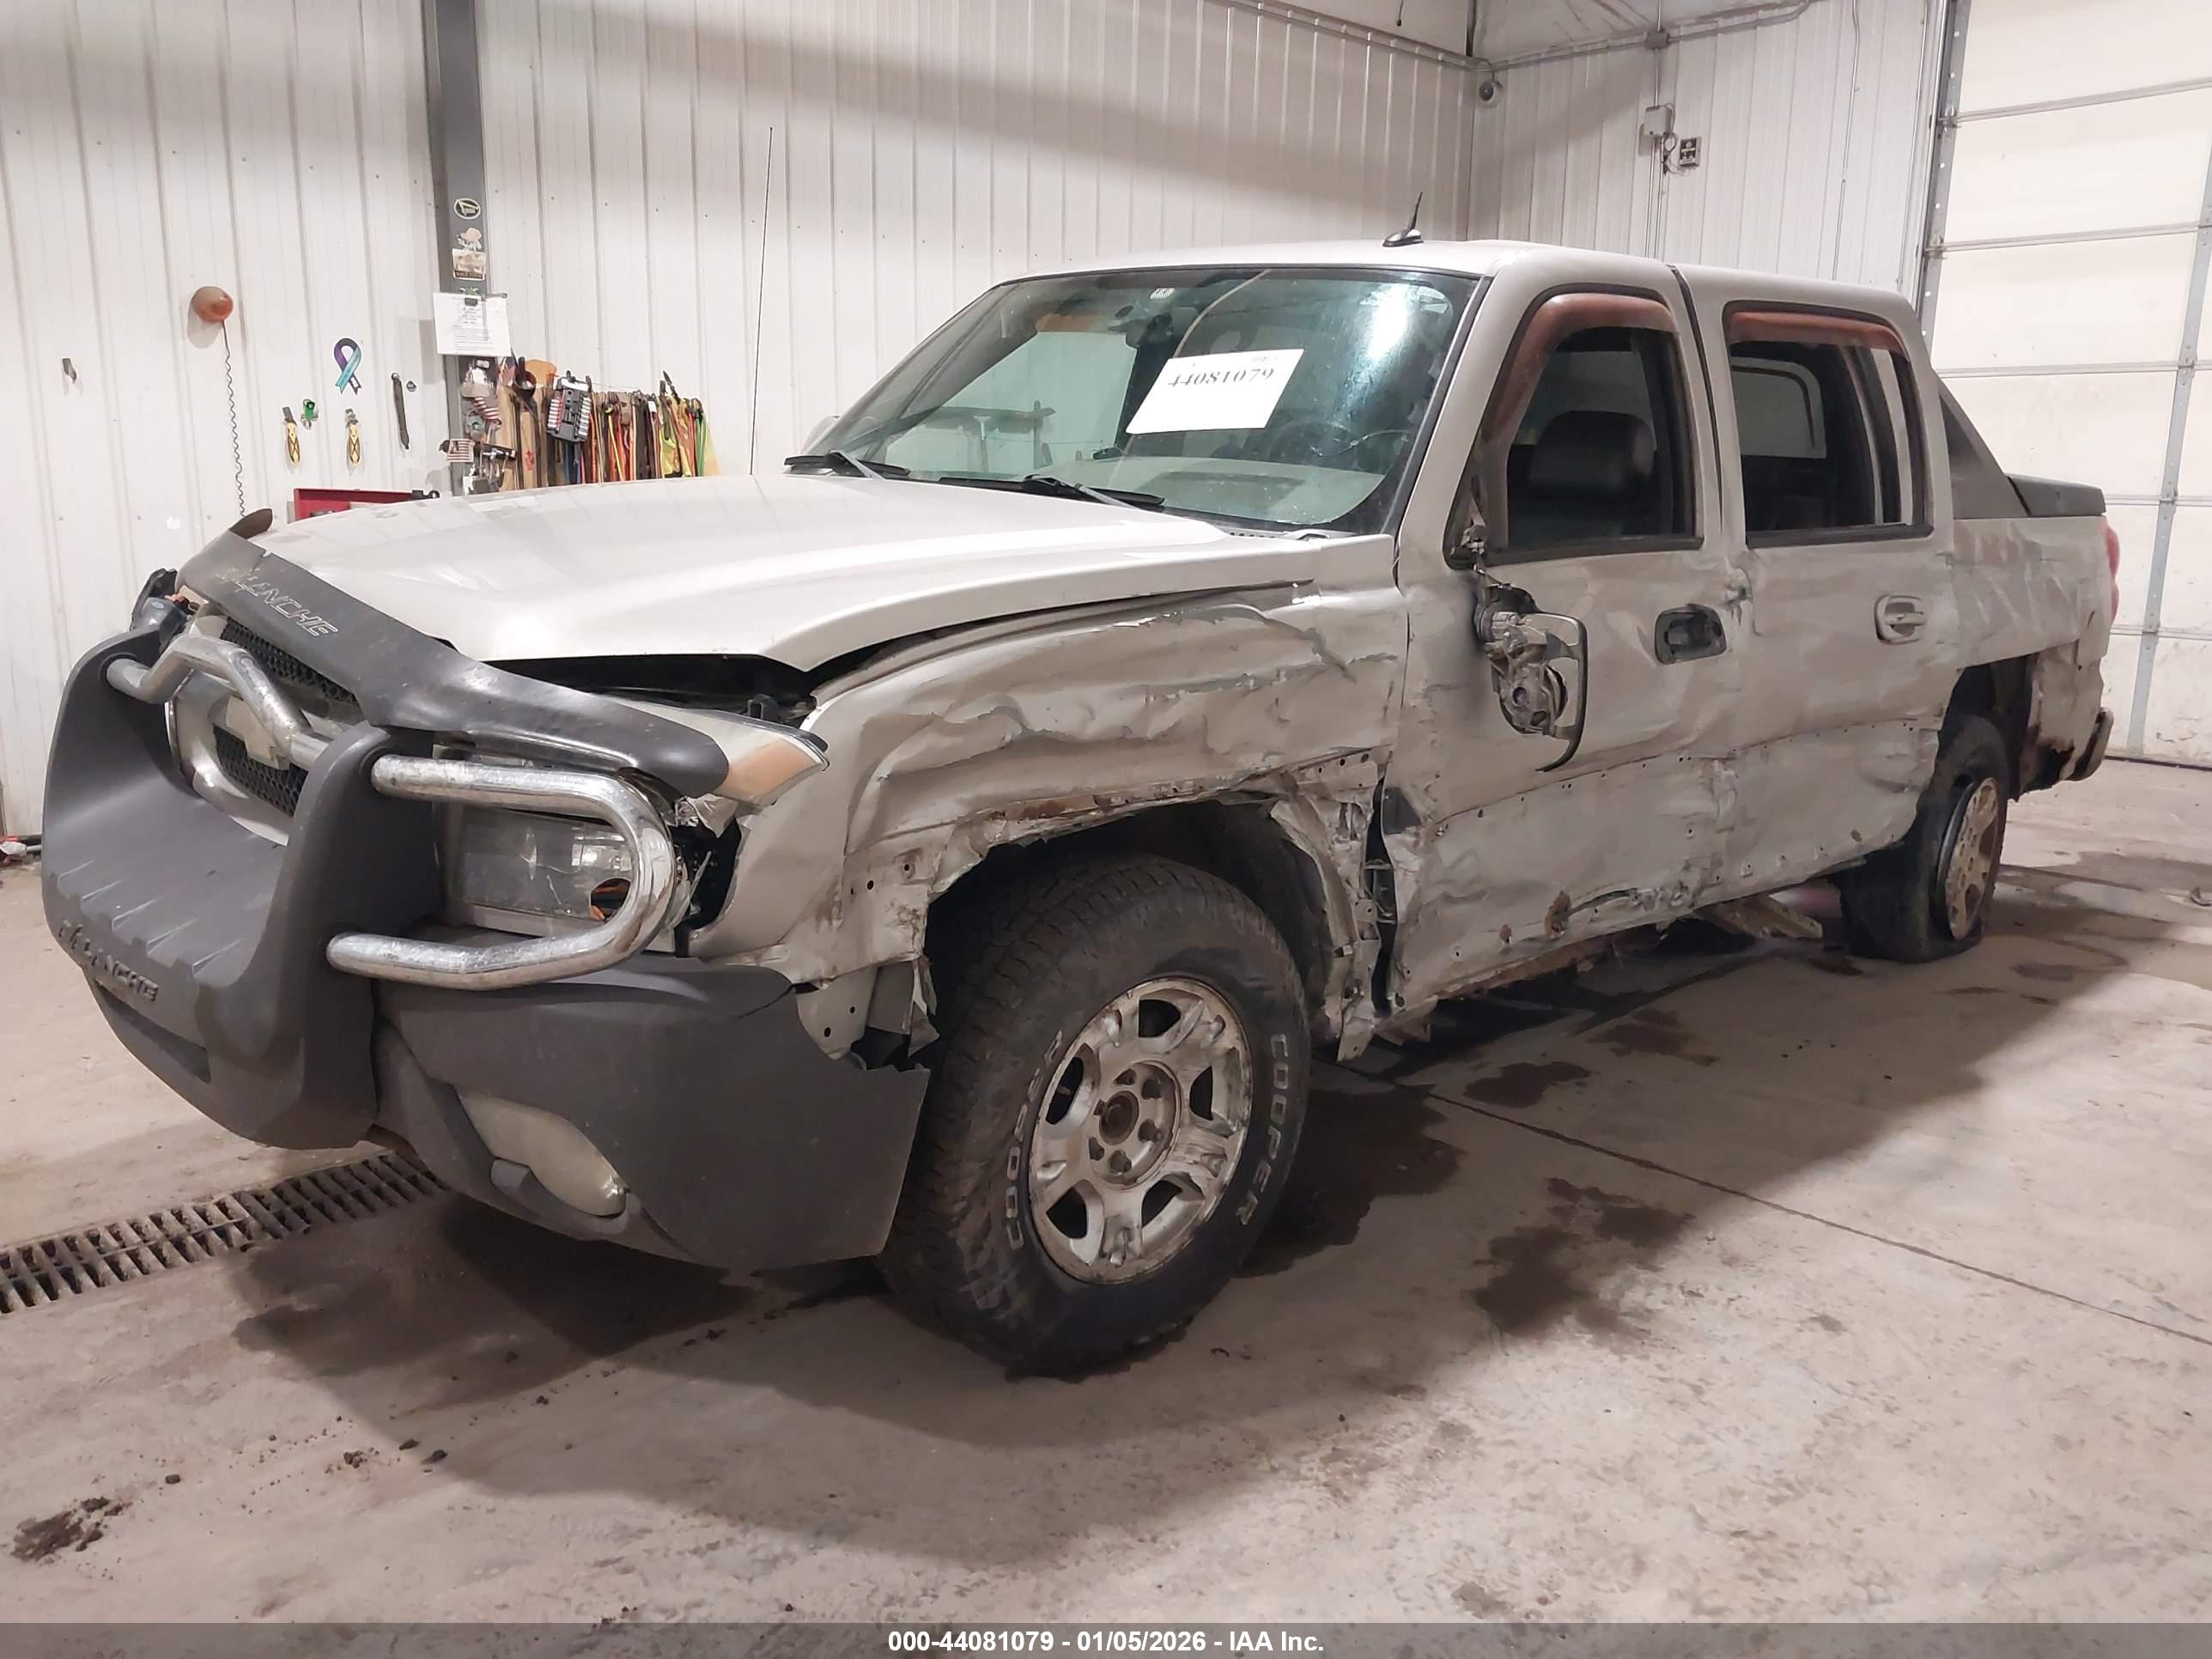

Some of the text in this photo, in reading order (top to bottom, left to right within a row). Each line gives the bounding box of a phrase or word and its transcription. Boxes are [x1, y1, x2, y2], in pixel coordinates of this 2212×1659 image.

[1168, 368, 1274, 387] 44081079
[215, 567, 339, 637] LANCHE
[1235, 1033, 1289, 1225] COOPER
